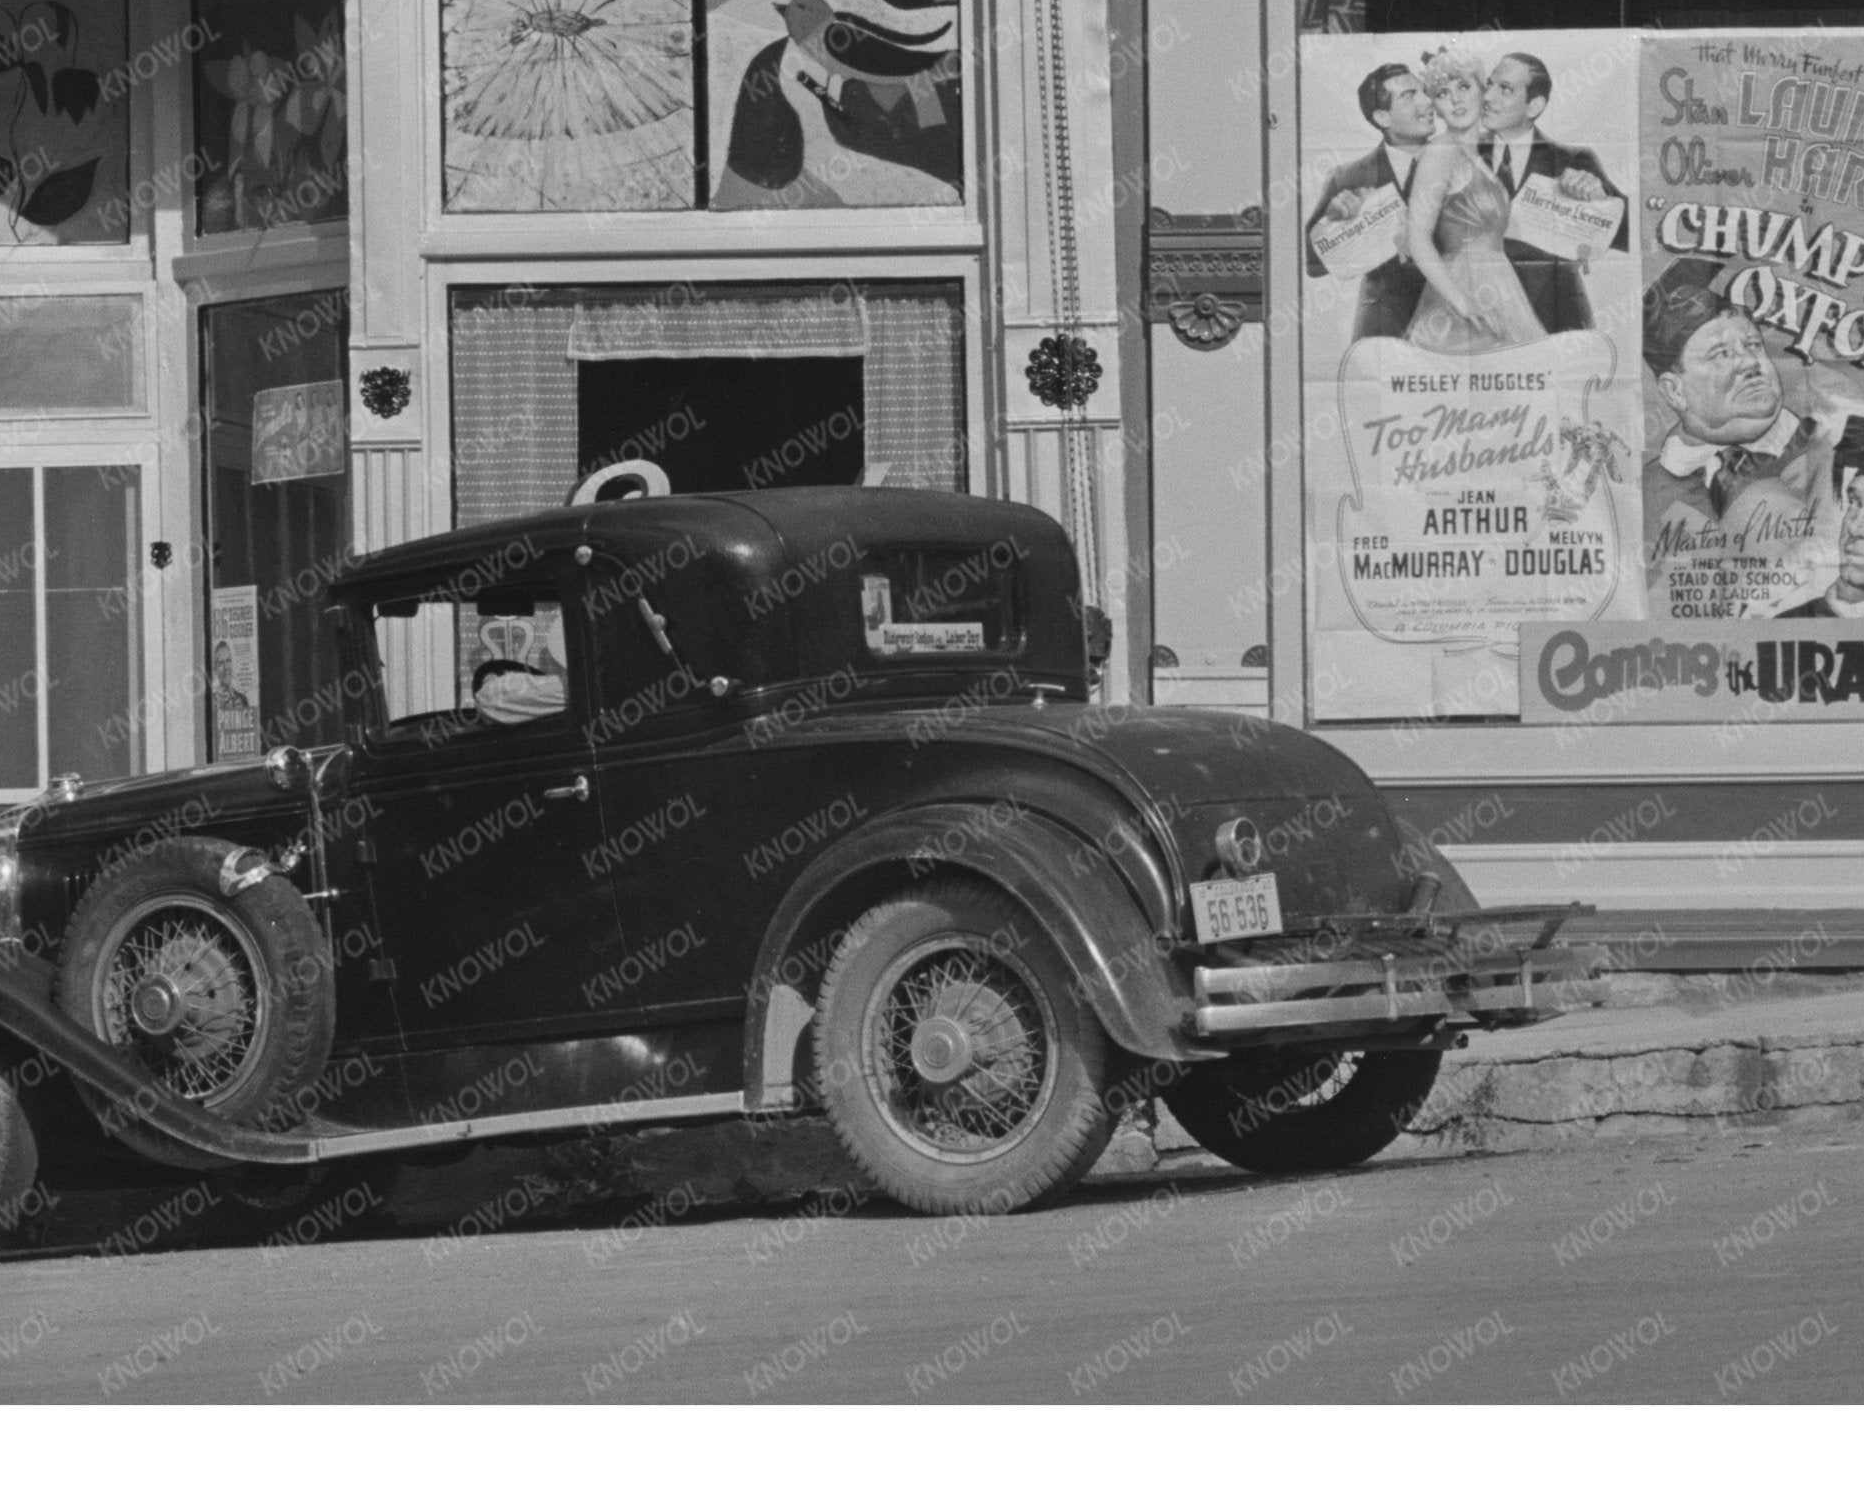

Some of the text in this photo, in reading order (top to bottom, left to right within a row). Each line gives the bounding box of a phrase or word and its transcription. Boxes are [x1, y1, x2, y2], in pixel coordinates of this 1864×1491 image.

[1691, 42, 1737, 65] That
[1660, 67, 1729, 126] Stan
[1660, 135, 1756, 187] Oliver
[1799, 197, 1815, 217] in
[1390, 374, 1461, 394] WESLEY
[1363, 403, 1531, 457] Too Many
[1393, 415, 1555, 487] Husbands
[1456, 489, 1497, 505] JEAN
[1422, 505, 1529, 536] ARTHUR
[1651, 497, 1821, 562] Masters of Mirth
[1352, 535, 1390, 551] FRED
[1548, 531, 1605, 546] MELVYN
[1504, 547, 1606, 577] DOUGLAS
[1731, 556, 1768, 570] TURN
[1775, 557, 1786, 570] A
[1668, 571, 1801, 587] STAID OLD SCHOOL
[1669, 587, 1771, 602] INTO A LAUGH
[1538, 629, 1721, 711] Coming
[216, 709, 255, 731] PRINCE
[218, 731, 256, 755] ALBERT
